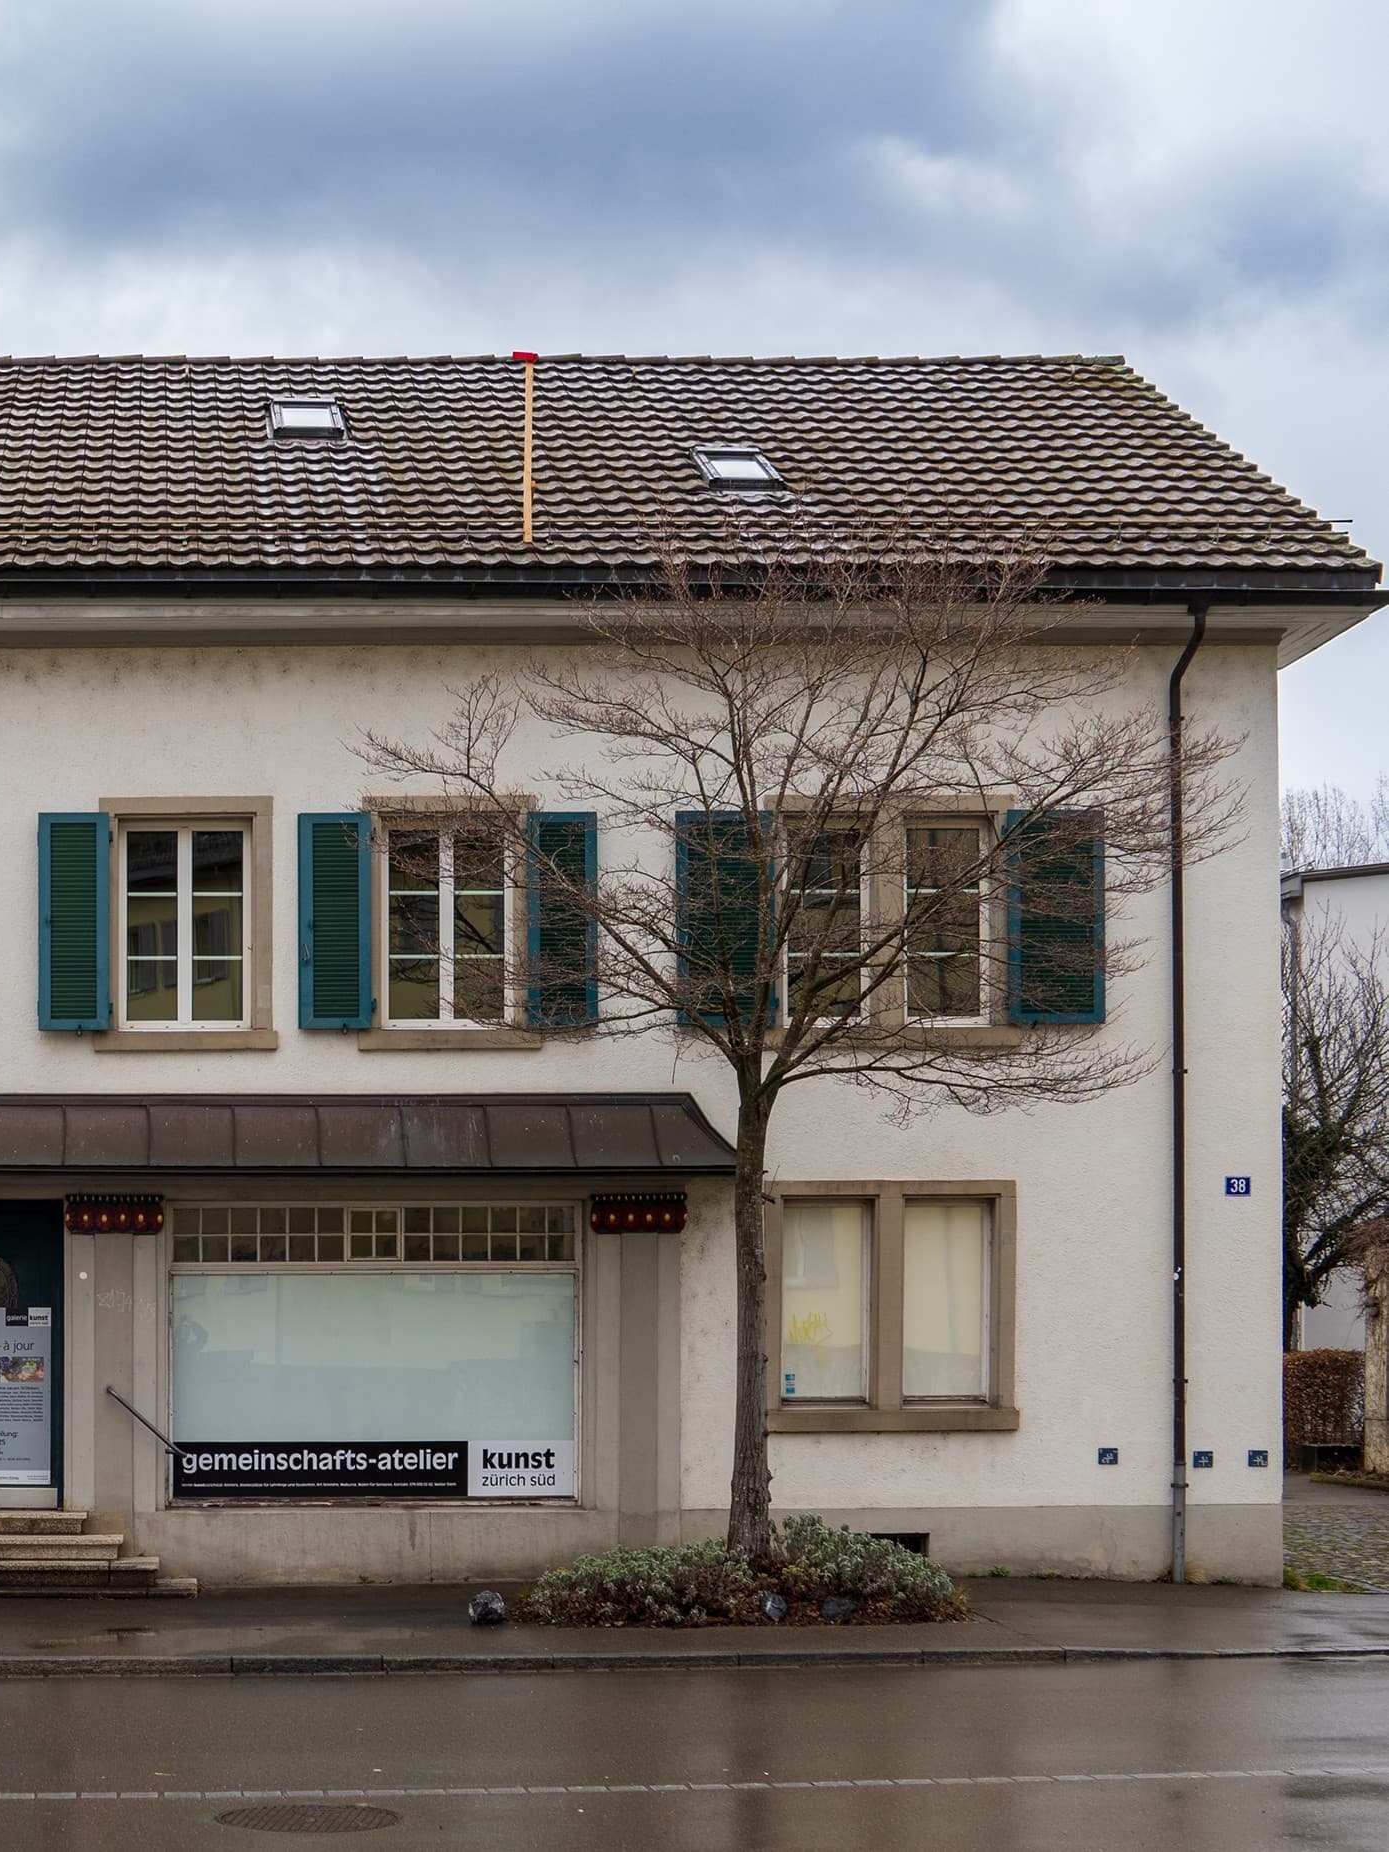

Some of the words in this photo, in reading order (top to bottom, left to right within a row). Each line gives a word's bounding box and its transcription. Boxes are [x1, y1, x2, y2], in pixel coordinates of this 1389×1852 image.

[1230, 1178, 1247, 1193] 38
[6, 1314, 28, 1322] galerie
[3, 1340, 10, 1351] à
[12, 1341, 35, 1354] jour
[182, 1449, 459, 1474] gemeinschafts-atelier
[482, 1448, 556, 1470] kunst
[482, 1473, 527, 1487] zürich
[530, 1473, 556, 1487] süd
